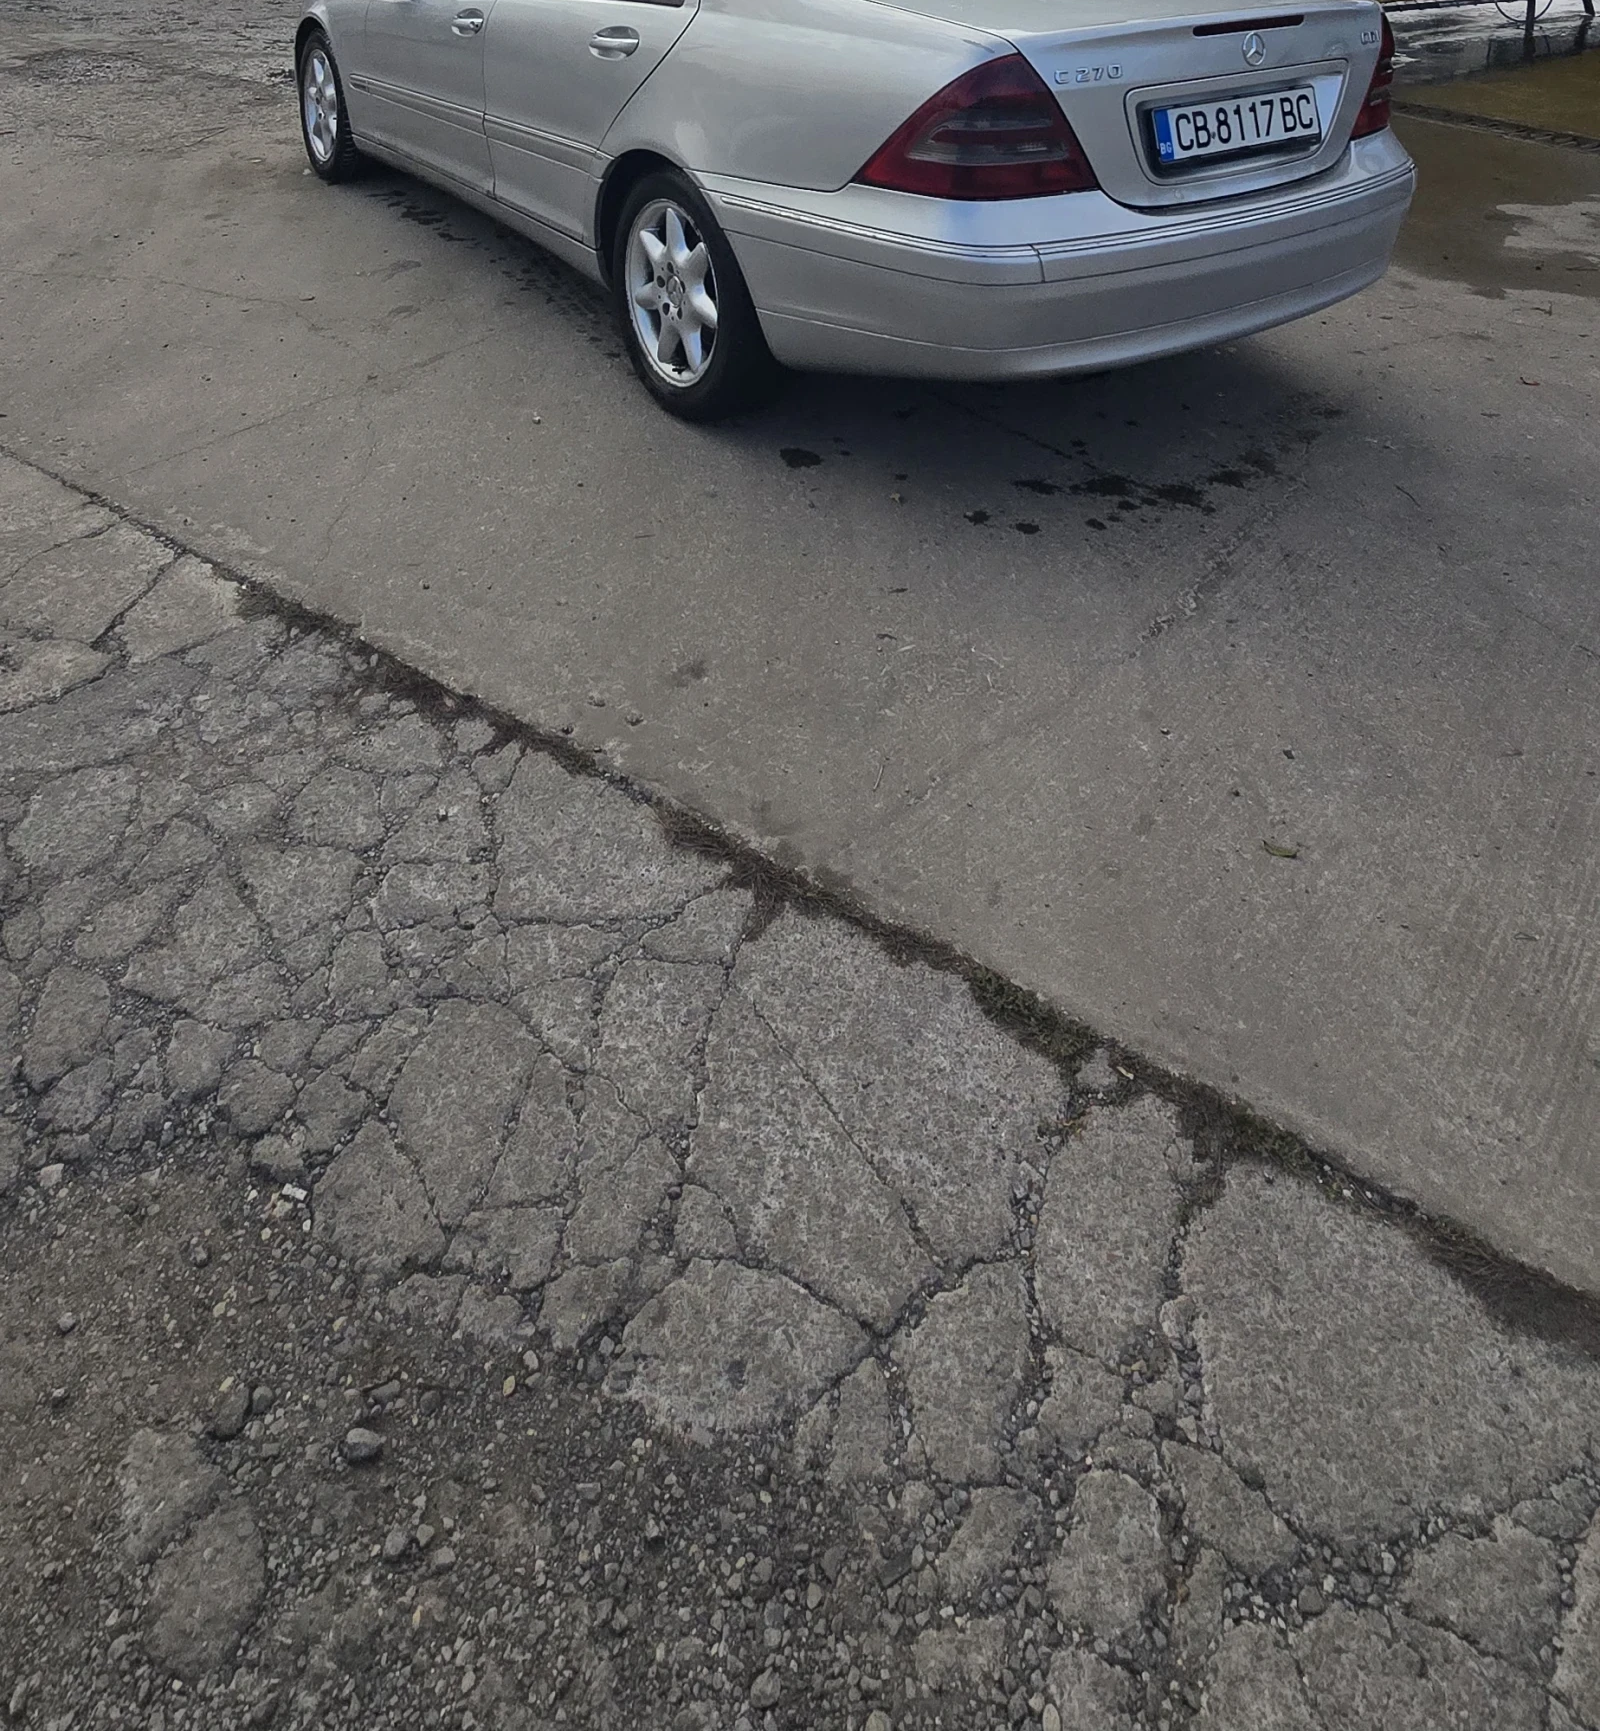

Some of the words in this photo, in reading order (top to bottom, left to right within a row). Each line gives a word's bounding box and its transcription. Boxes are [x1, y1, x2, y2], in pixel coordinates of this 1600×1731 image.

[1054, 69, 1070, 85] C
[1075, 63, 1123, 83] 270
[1159, 141, 1172, 154] BG
